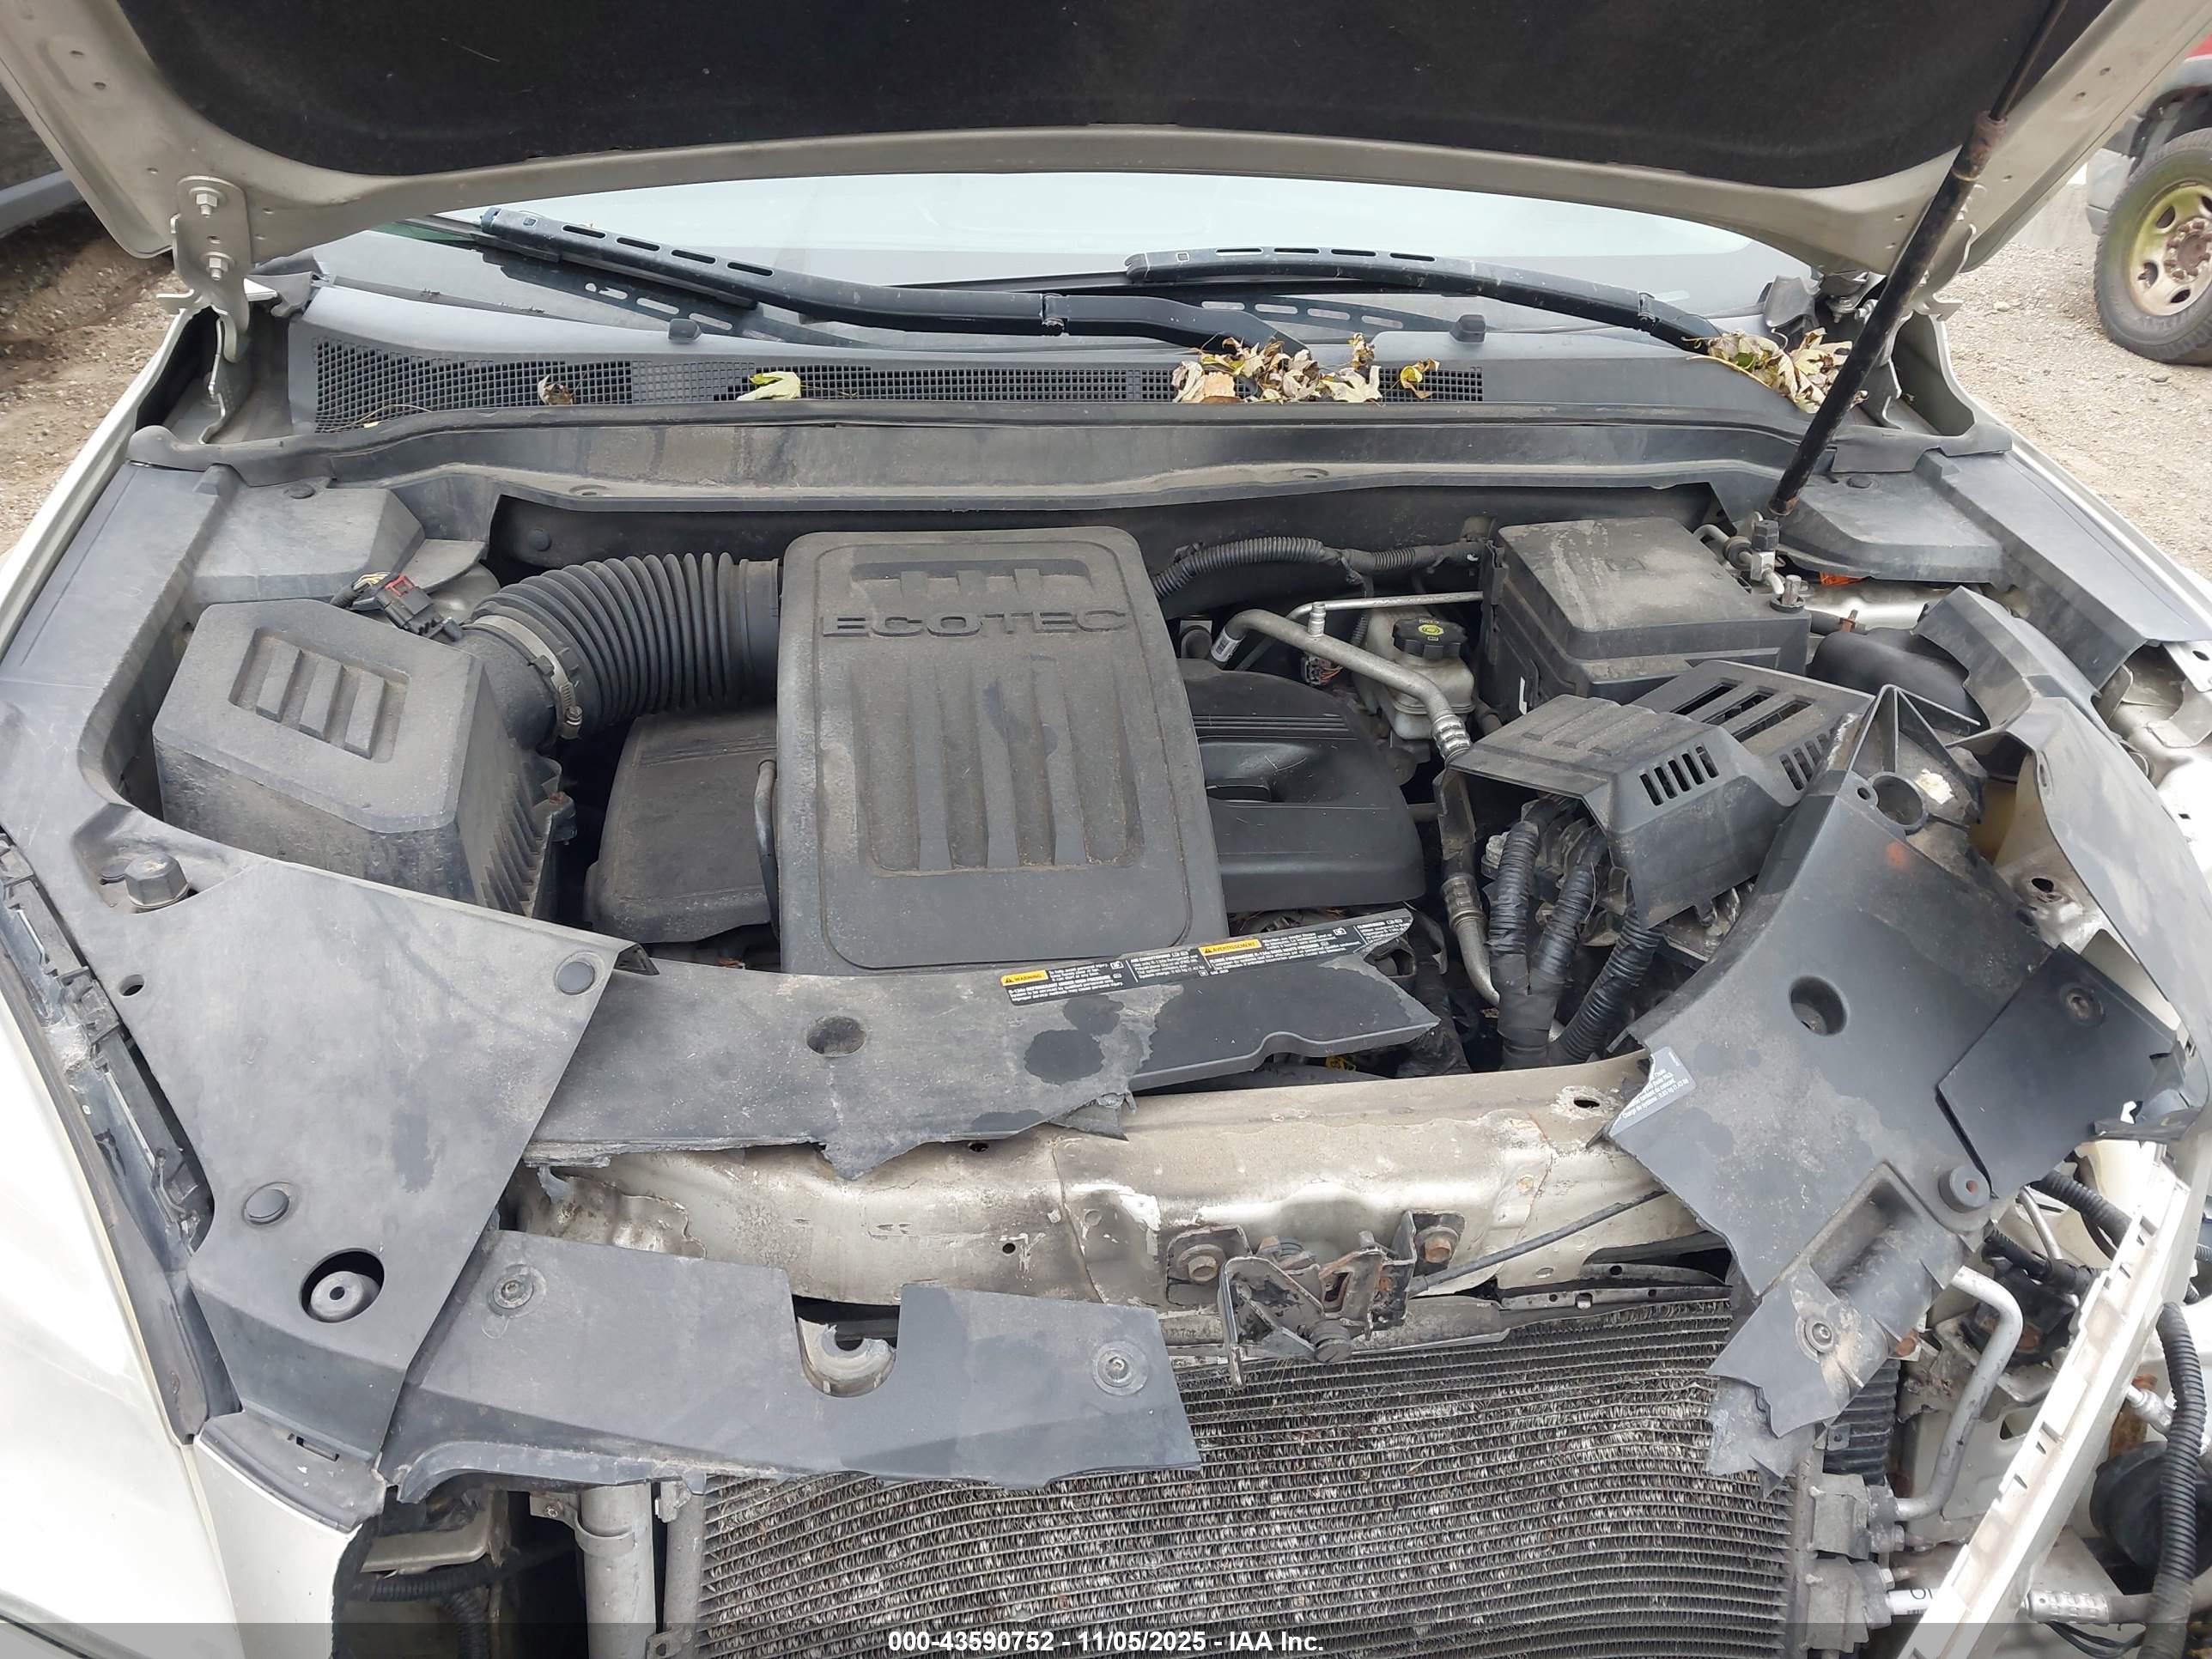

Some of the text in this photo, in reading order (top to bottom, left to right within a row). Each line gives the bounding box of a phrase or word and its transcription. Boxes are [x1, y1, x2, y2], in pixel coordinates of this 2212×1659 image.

[821, 611, 1128, 638] ECOTEC
[1212, 941, 1255, 951] AVERTISSEMENT
[1015, 973, 1043, 981] WARNING
